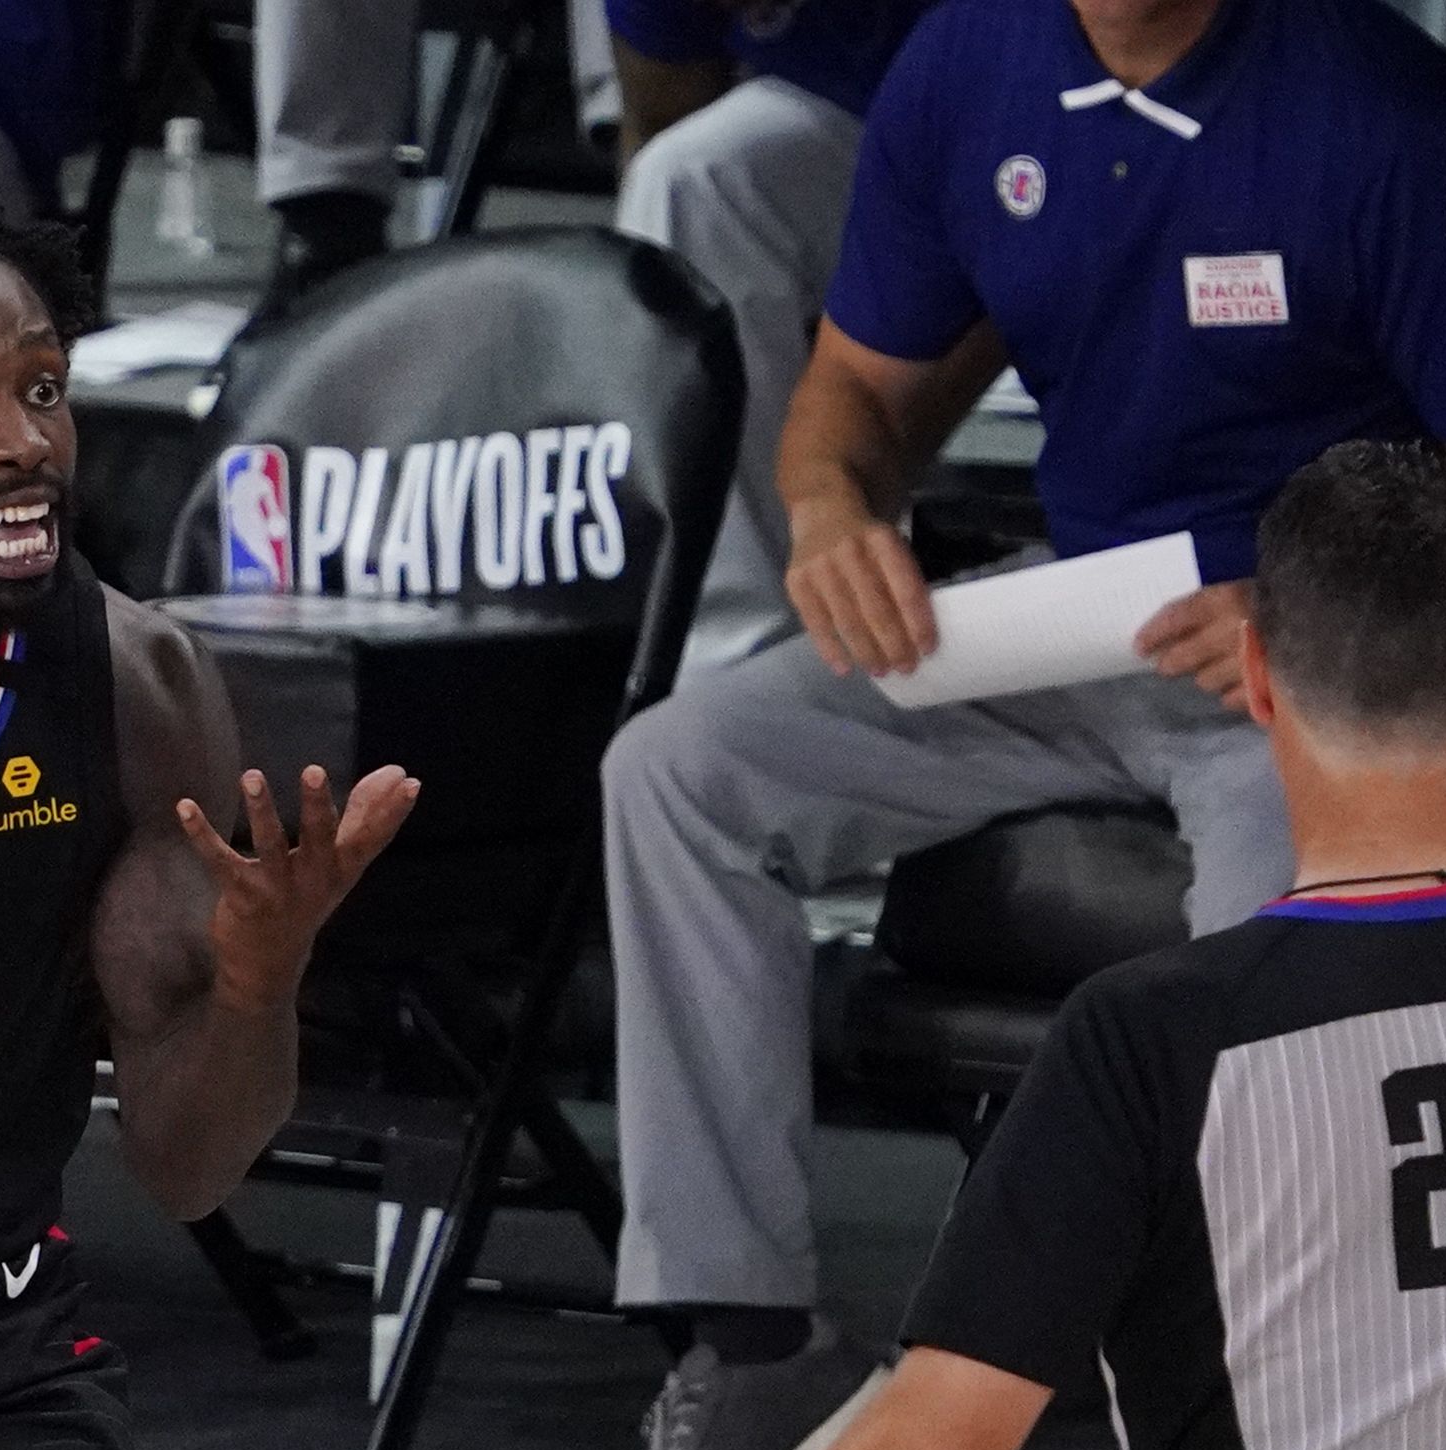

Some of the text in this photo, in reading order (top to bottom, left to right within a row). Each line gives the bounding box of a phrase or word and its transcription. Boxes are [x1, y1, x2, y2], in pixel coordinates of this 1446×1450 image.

[1197, 282, 1277, 299] RACIAL
[1196, 300, 1282, 320] JUSTICE
[301, 421, 631, 595] PLAYOFFS
